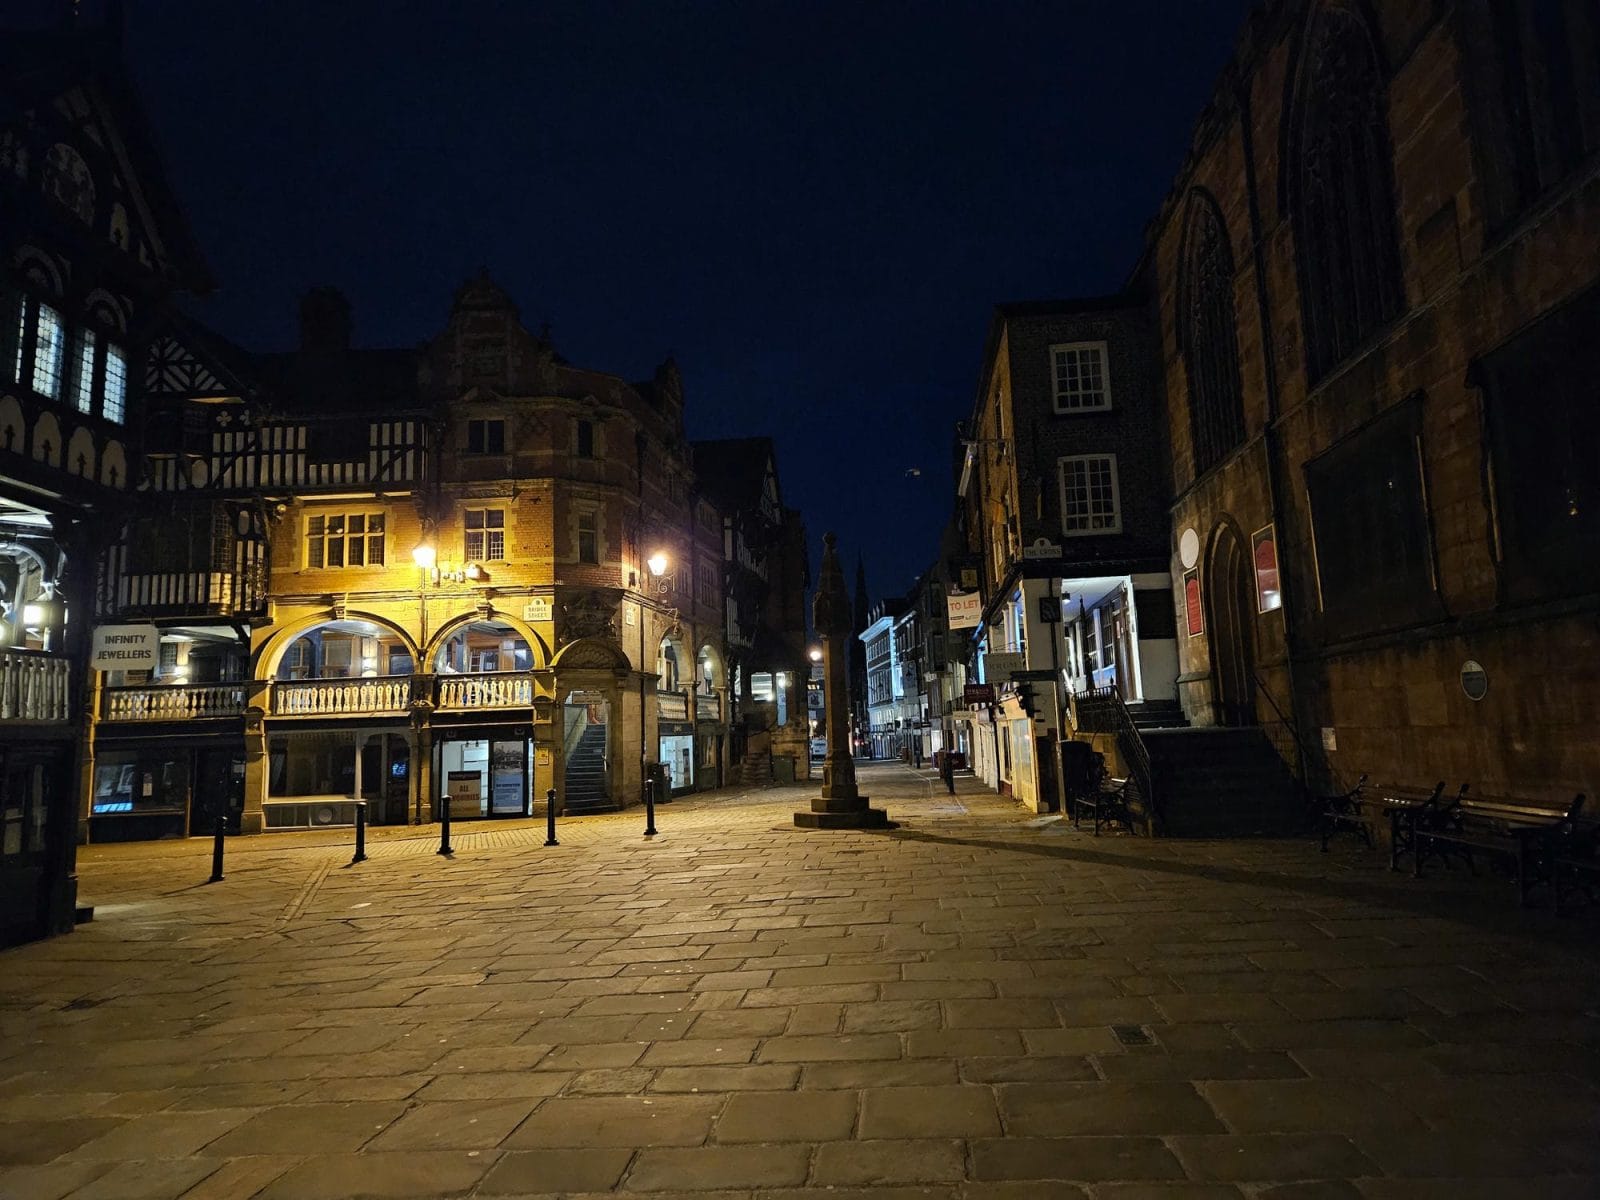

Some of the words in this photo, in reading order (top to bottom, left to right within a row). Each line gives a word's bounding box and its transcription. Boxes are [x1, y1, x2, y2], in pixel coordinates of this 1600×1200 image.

[950, 602, 961, 611] TO
[963, 599, 979, 609] LET
[104, 634, 147, 645] INFINITY
[96, 650, 152, 660] JEWELLERS
